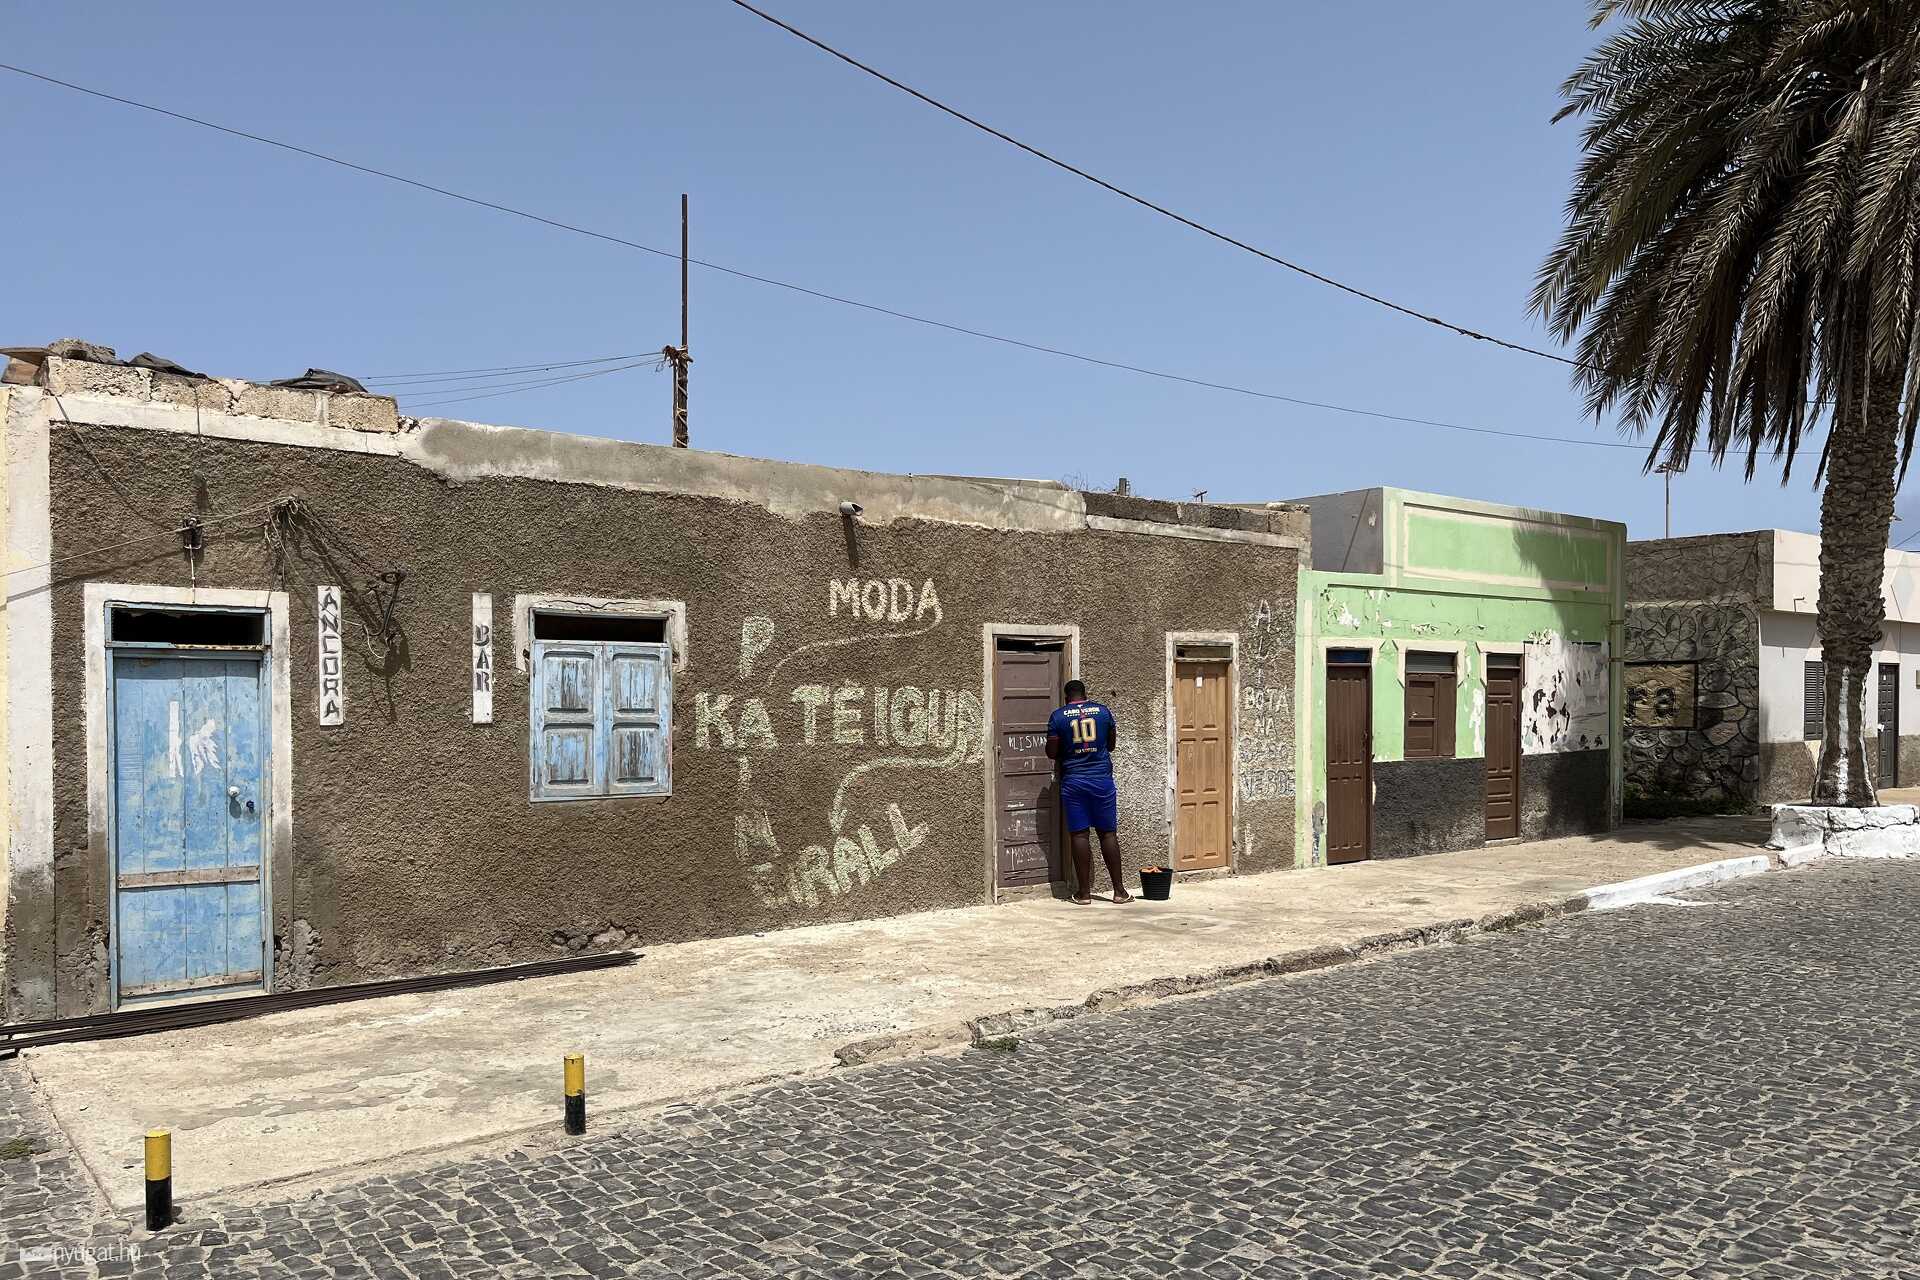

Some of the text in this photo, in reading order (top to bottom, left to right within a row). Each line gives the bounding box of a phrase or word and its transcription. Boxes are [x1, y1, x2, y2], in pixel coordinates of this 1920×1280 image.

[829, 577, 943, 624] MODA
[474, 624, 490, 692] BAR
[1070, 717, 1097, 744] 10
